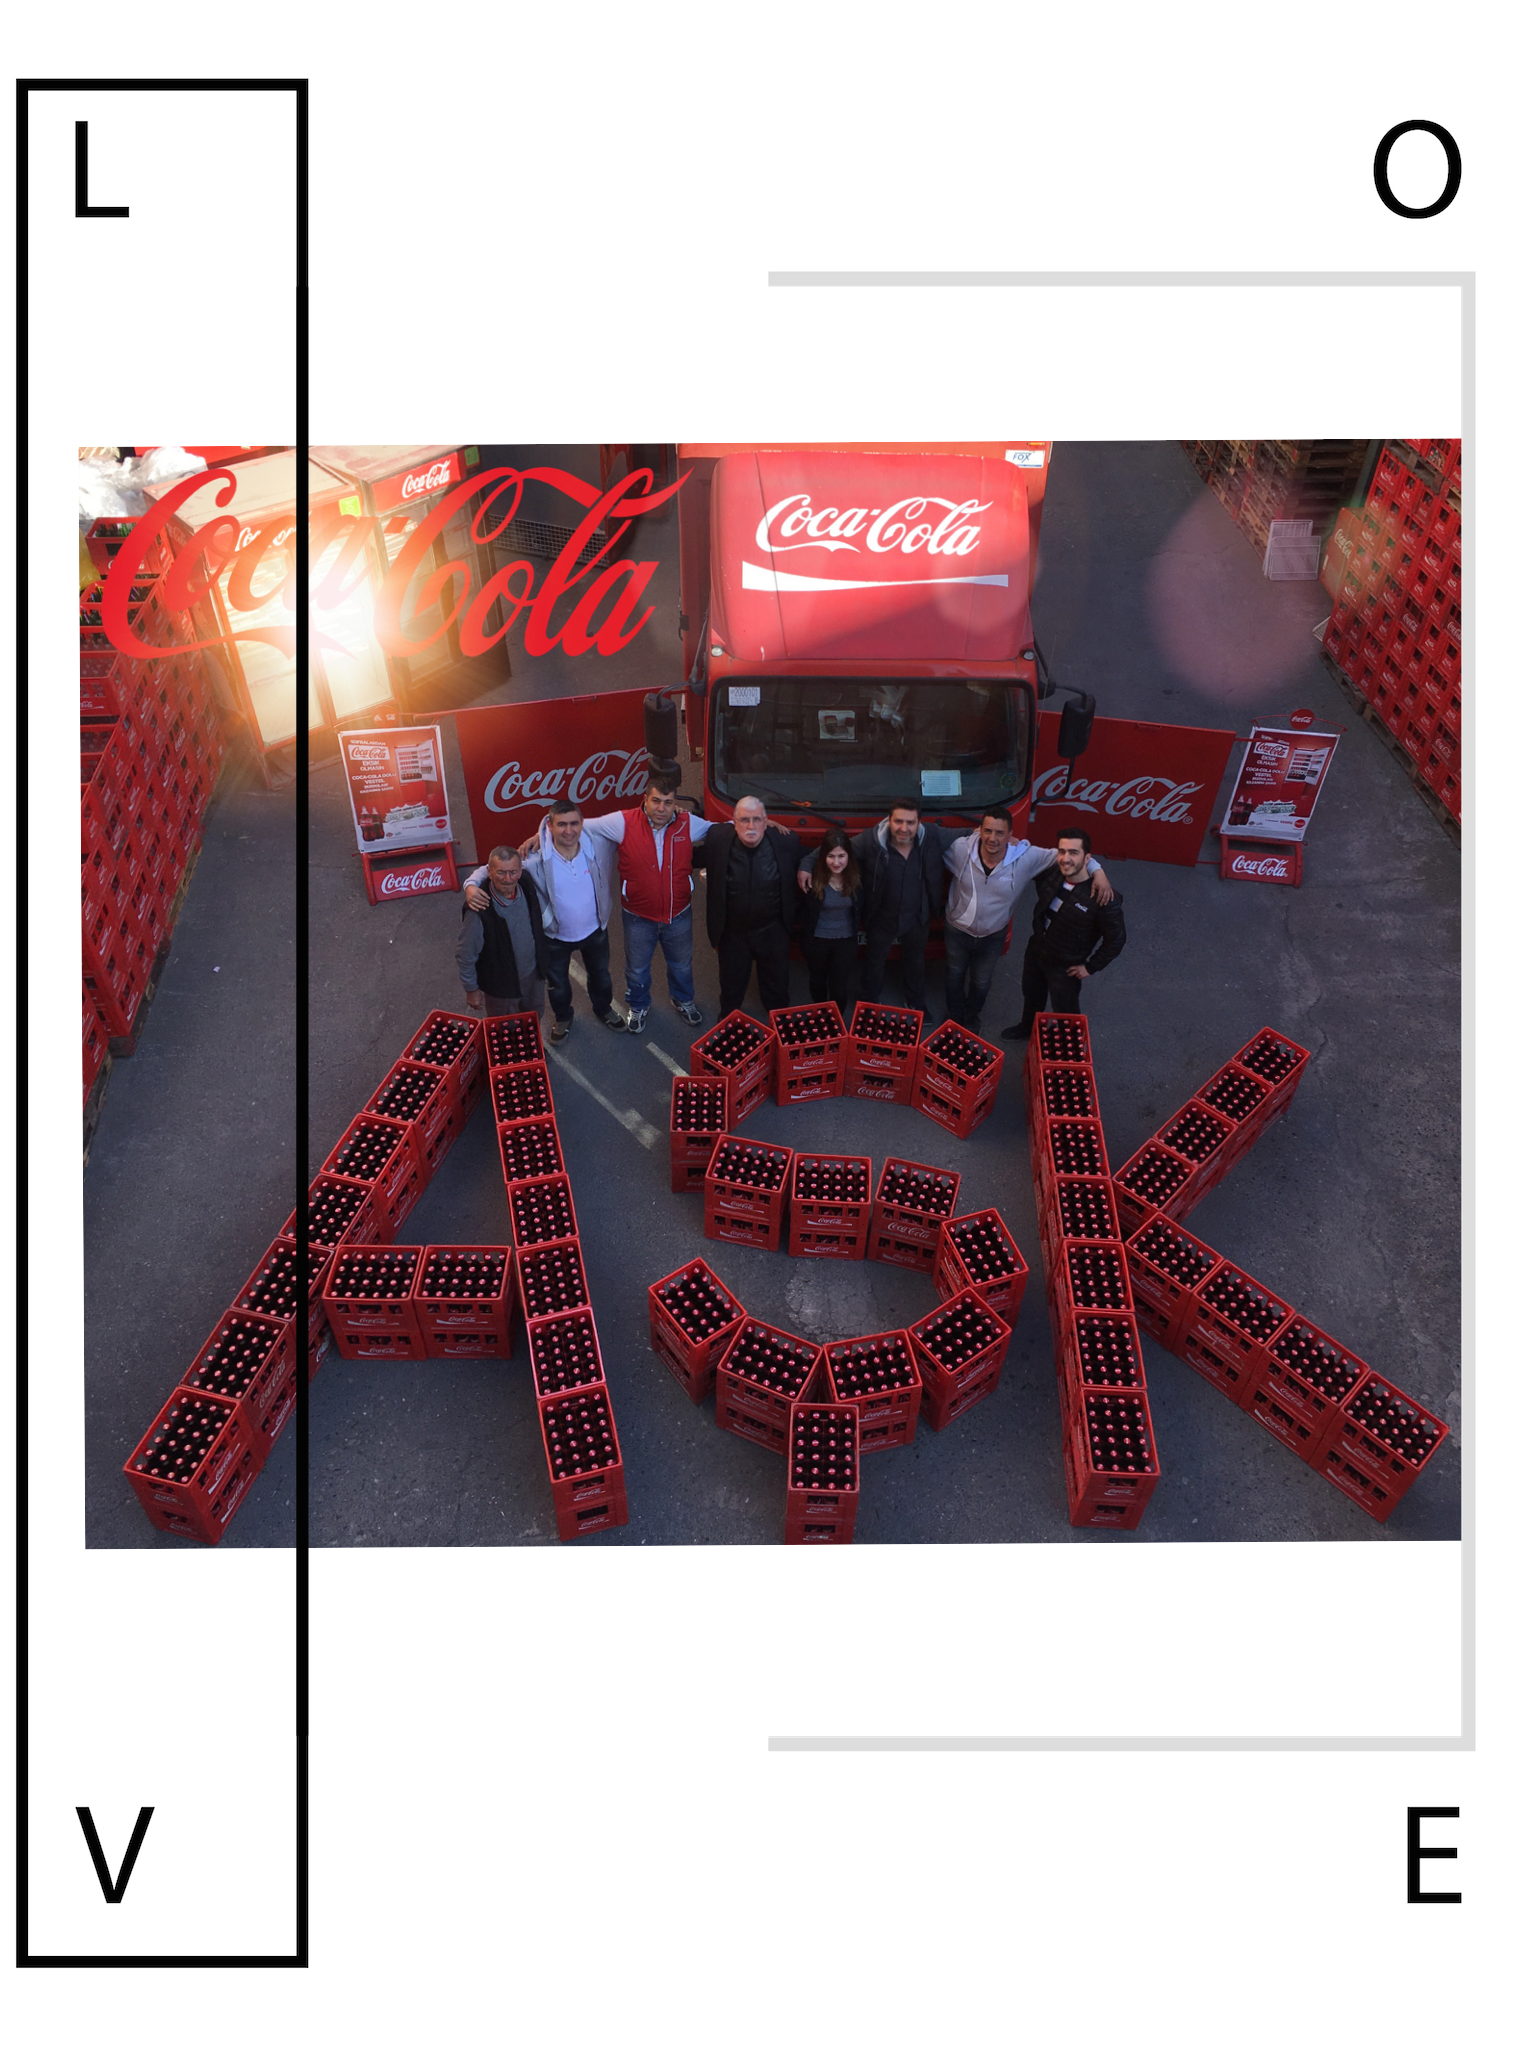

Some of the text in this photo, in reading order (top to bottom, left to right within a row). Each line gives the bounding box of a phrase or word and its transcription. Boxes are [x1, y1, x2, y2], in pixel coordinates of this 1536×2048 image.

[402, 460, 451, 499] Coca-Cola
[756, 494, 994, 556] Coca-Cola
[351, 746, 387, 759] Coca-Cola
[484, 747, 651, 813] Coca-Cola
[1032, 765, 1205, 823] Coca-Cola
[381, 866, 443, 894] Coca-Cola
[1232, 855, 1289, 877] Coca-Cola
[857, 1087, 896, 1099] Coca-Cola
[887, 1222, 931, 1239] Coca-Cola
